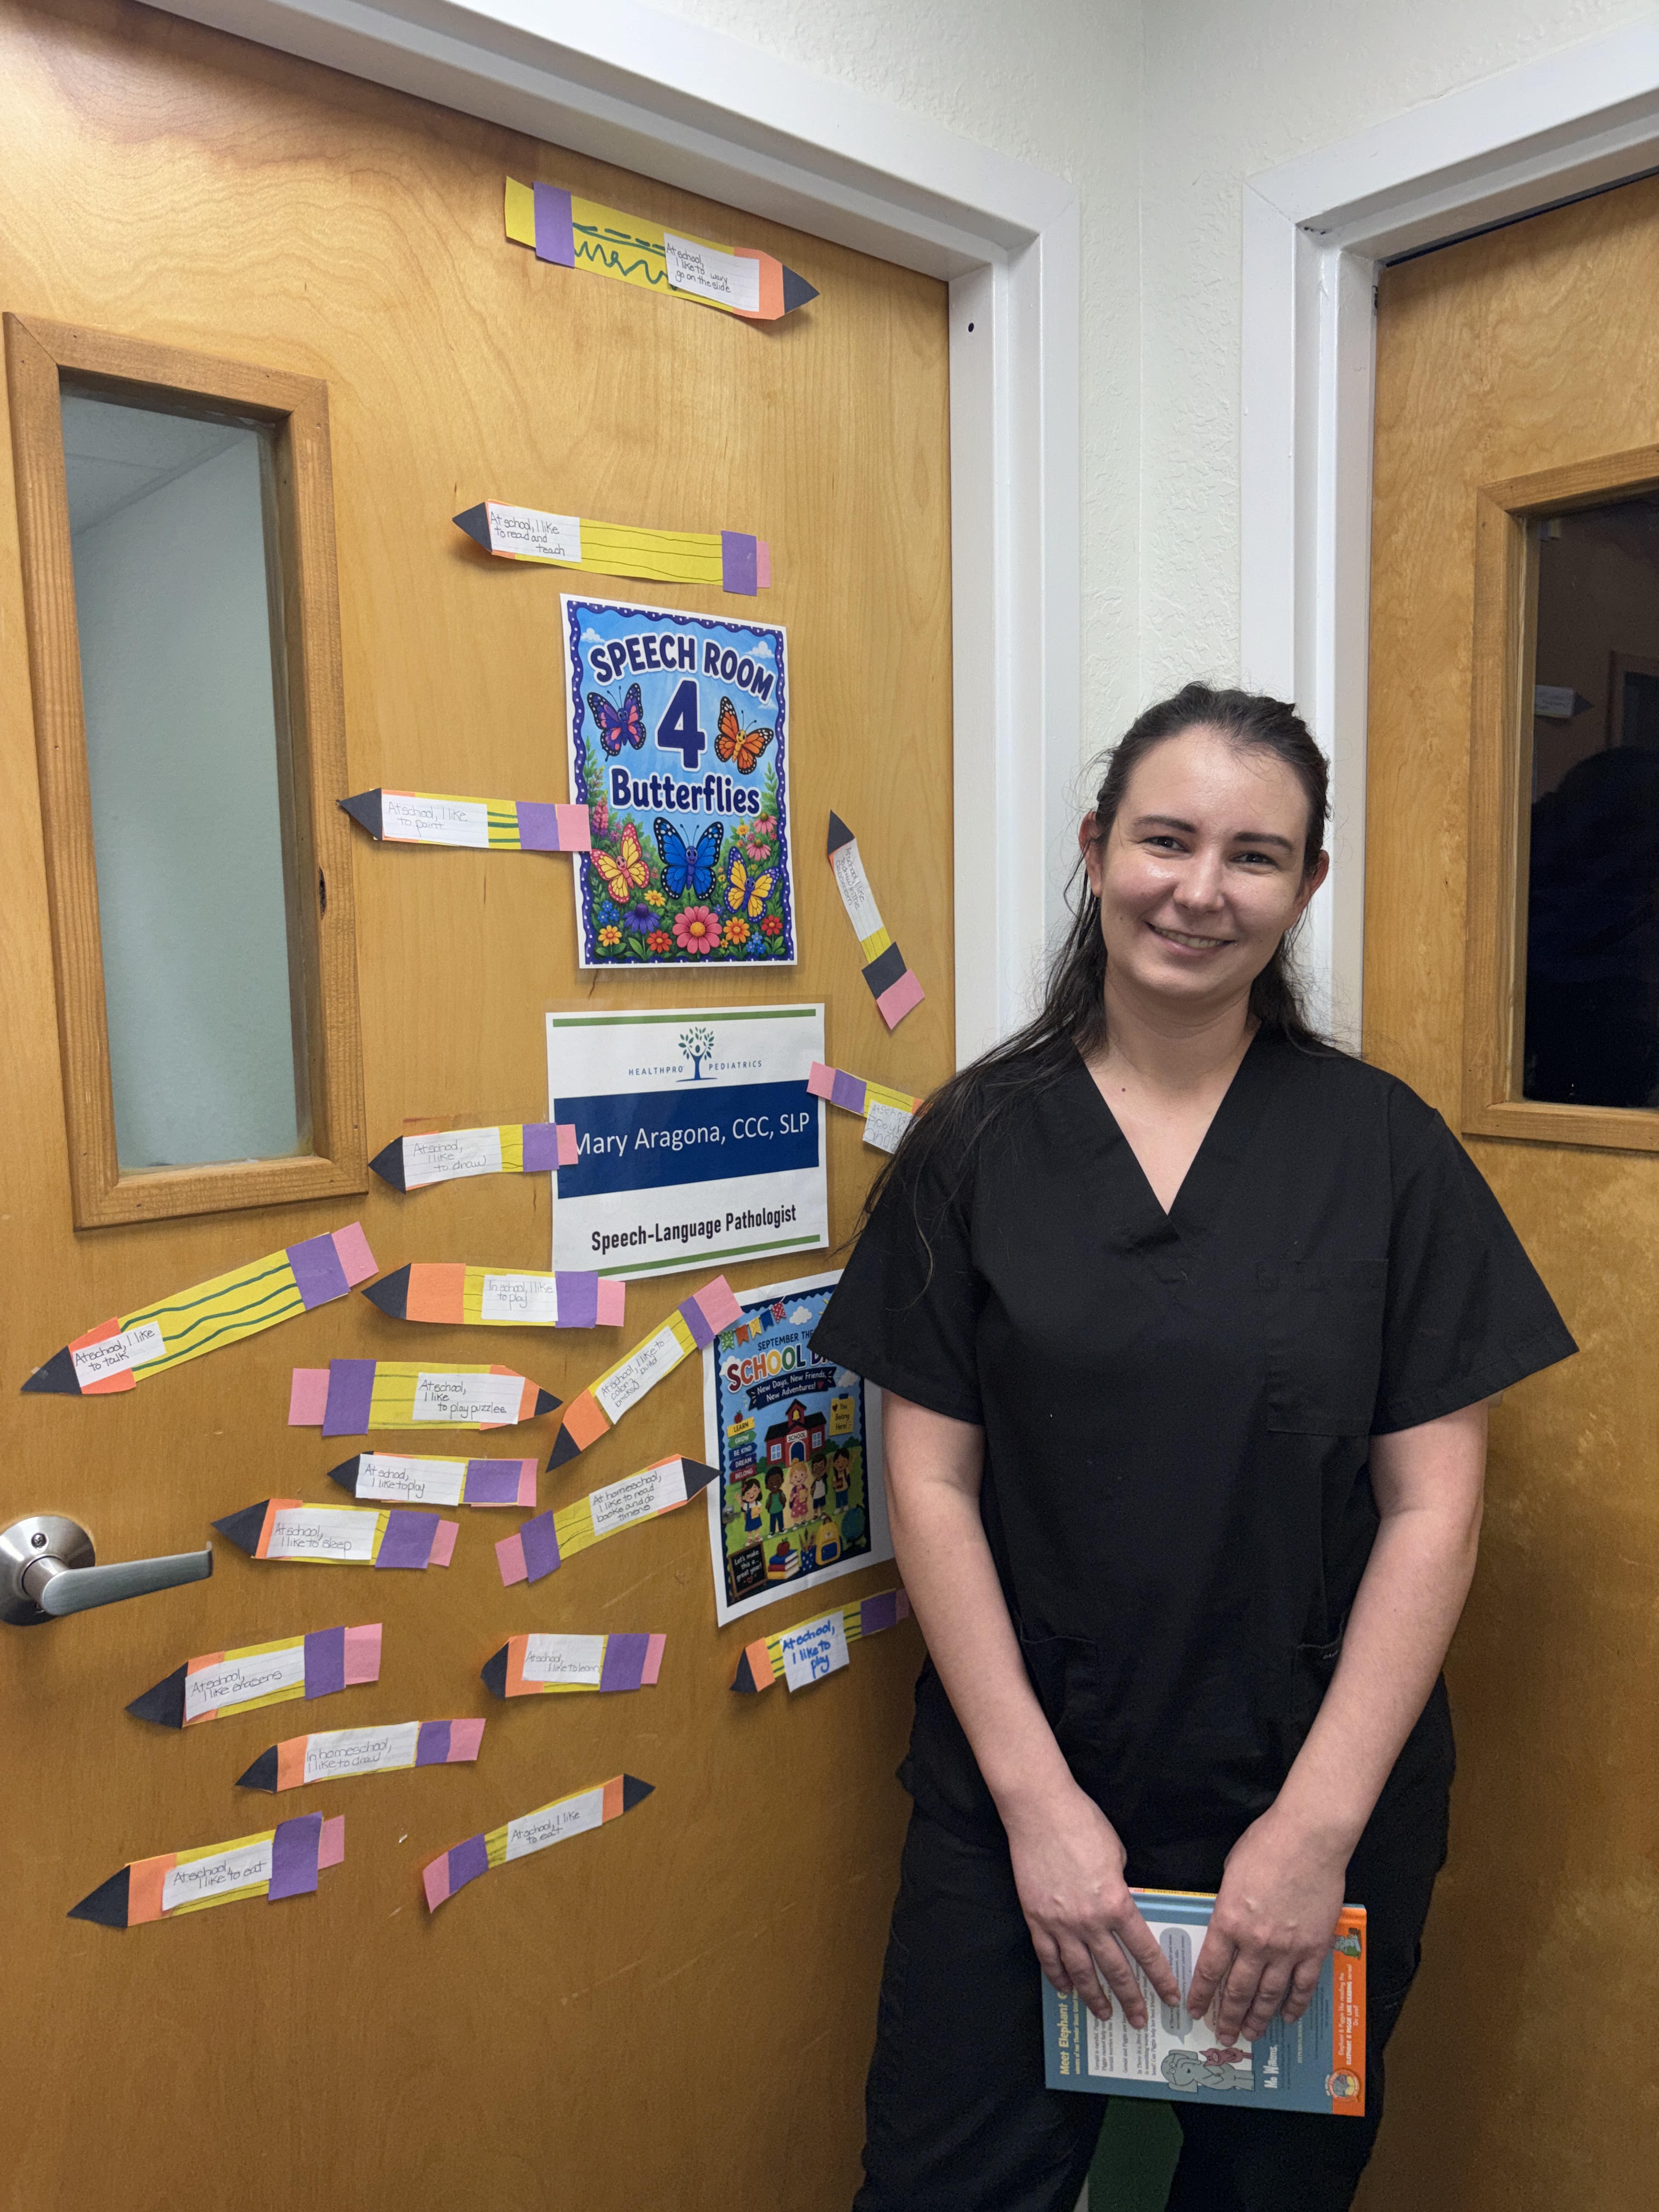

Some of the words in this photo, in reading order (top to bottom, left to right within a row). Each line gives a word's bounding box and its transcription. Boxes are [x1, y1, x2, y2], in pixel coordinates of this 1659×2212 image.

[667, 243, 676, 256] At
[678, 250, 704, 268] school,
[682, 261, 695, 272] like
[695, 264, 705, 275] to
[675, 270, 685, 282] go
[687, 273, 696, 281] on
[697, 275, 712, 286] the
[713, 280, 731, 293] slide
[490, 511, 503, 524] At
[505, 518, 534, 533] school,
[543, 523, 560, 534] like
[494, 527, 505, 538] to
[507, 531, 529, 540] read
[532, 533, 547, 543] and
[536, 544, 565, 556] teach
[590, 635, 695, 682] SPEECH
[704, 642, 774, 701] ROOM
[658, 680, 705, 769] 4
[612, 768, 759, 814] Butterflies
[388, 802, 401, 814] At
[403, 806, 437, 822] school,
[449, 809, 467, 821] like
[397, 818, 411, 826] to
[416, 820, 444, 837] paint
[629, 1065, 683, 1076] HEALTHPRO
[708, 1060, 762, 1070] PEDIATRICS
[576, 1133, 628, 1157] Mary
[634, 1126, 726, 1151] Aragona,
[732, 1116, 774, 1139] CCC,
[780, 1113, 809, 1134] SLP
[413, 1143, 426, 1157] At
[428, 1140, 462, 1153] school,
[432, 1153, 454, 1163] like
[453, 1155, 486, 1170] draw
[591, 1217, 721, 1255] Speech-Language
[726, 1205, 796, 1232] Pathologist
[488, 1280, 497, 1290] In
[500, 1282, 527, 1295] school,
[535, 1282, 553, 1293] like
[498, 1293, 507, 1301] to
[509, 1294, 527, 1310] play
[76, 1353, 88, 1366] At
[89, 1340, 126, 1359] school,
[134, 1329, 155, 1342] like
[758, 1333, 798, 1351] SEPTEMBER
[88, 1362, 101, 1371] to
[103, 1352, 129, 1366] talk
[727, 1345, 805, 1391] SCHOOL
[419, 1379, 435, 1391] At
[435, 1381, 466, 1395] school,
[611, 1381, 628, 1400] color
[757, 1385, 770, 1395] New
[805, 1370, 826, 1379] Friends,
[766, 1392, 779, 1402] New
[782, 1382, 816, 1396] Adventures!
[431, 1392, 449, 1401] like
[438, 1402, 447, 1411] to
[450, 1402, 468, 1419] play
[734, 1421, 748, 1432] LEARN
[788, 1432, 806, 1441] SCHOOL
[736, 1457, 752, 1468] DREAM
[365, 1464, 377, 1475] At
[379, 1468, 408, 1481] school,
[735, 1468, 753, 1479] BELONG
[379, 1479, 395, 1488] like
[408, 1481, 425, 1499] play
[605, 1498, 622, 1510] like
[635, 1483, 654, 1498] read
[593, 1496, 603, 1505] At
[597, 1508, 624, 1522] books
[625, 1498, 644, 1509] and
[645, 1495, 654, 1503] do
[276, 1523, 286, 1535] At
[286, 1525, 323, 1541] school,
[287, 1537, 304, 1547] like
[306, 1538, 318, 1547] to
[323, 1538, 351, 1558] sleep
[783, 1638, 795, 1652] At
[797, 1620, 835, 1645] school,
[526, 1651, 535, 1662] At
[536, 1652, 563, 1664] school,
[800, 1646, 819, 1661] like
[818, 1640, 831, 1651] to
[554, 1663, 567, 1672] like
[578, 1663, 600, 1672] learn
[811, 1655, 830, 1679] play
[191, 1682, 206, 1697] At
[206, 1669, 244, 1689] school,
[210, 1685, 229, 1698] like
[307, 1751, 316, 1761] In
[319, 1737, 392, 1759] homeschool,
[314, 1760, 336, 1770] like
[352, 1752, 381, 1765] draw
[511, 1830, 522, 1842] At
[563, 1812, 579, 1822] like
[173, 1872, 188, 1887] At
[205, 1875, 226, 1887] like
[229, 1870, 240, 1881] to
[244, 1861, 267, 1876] eat
[1057, 2004, 1071, 2047] Elephant
[1059, 2051, 1070, 2074] Meet
[1264, 2076, 1277, 2088] Mo
